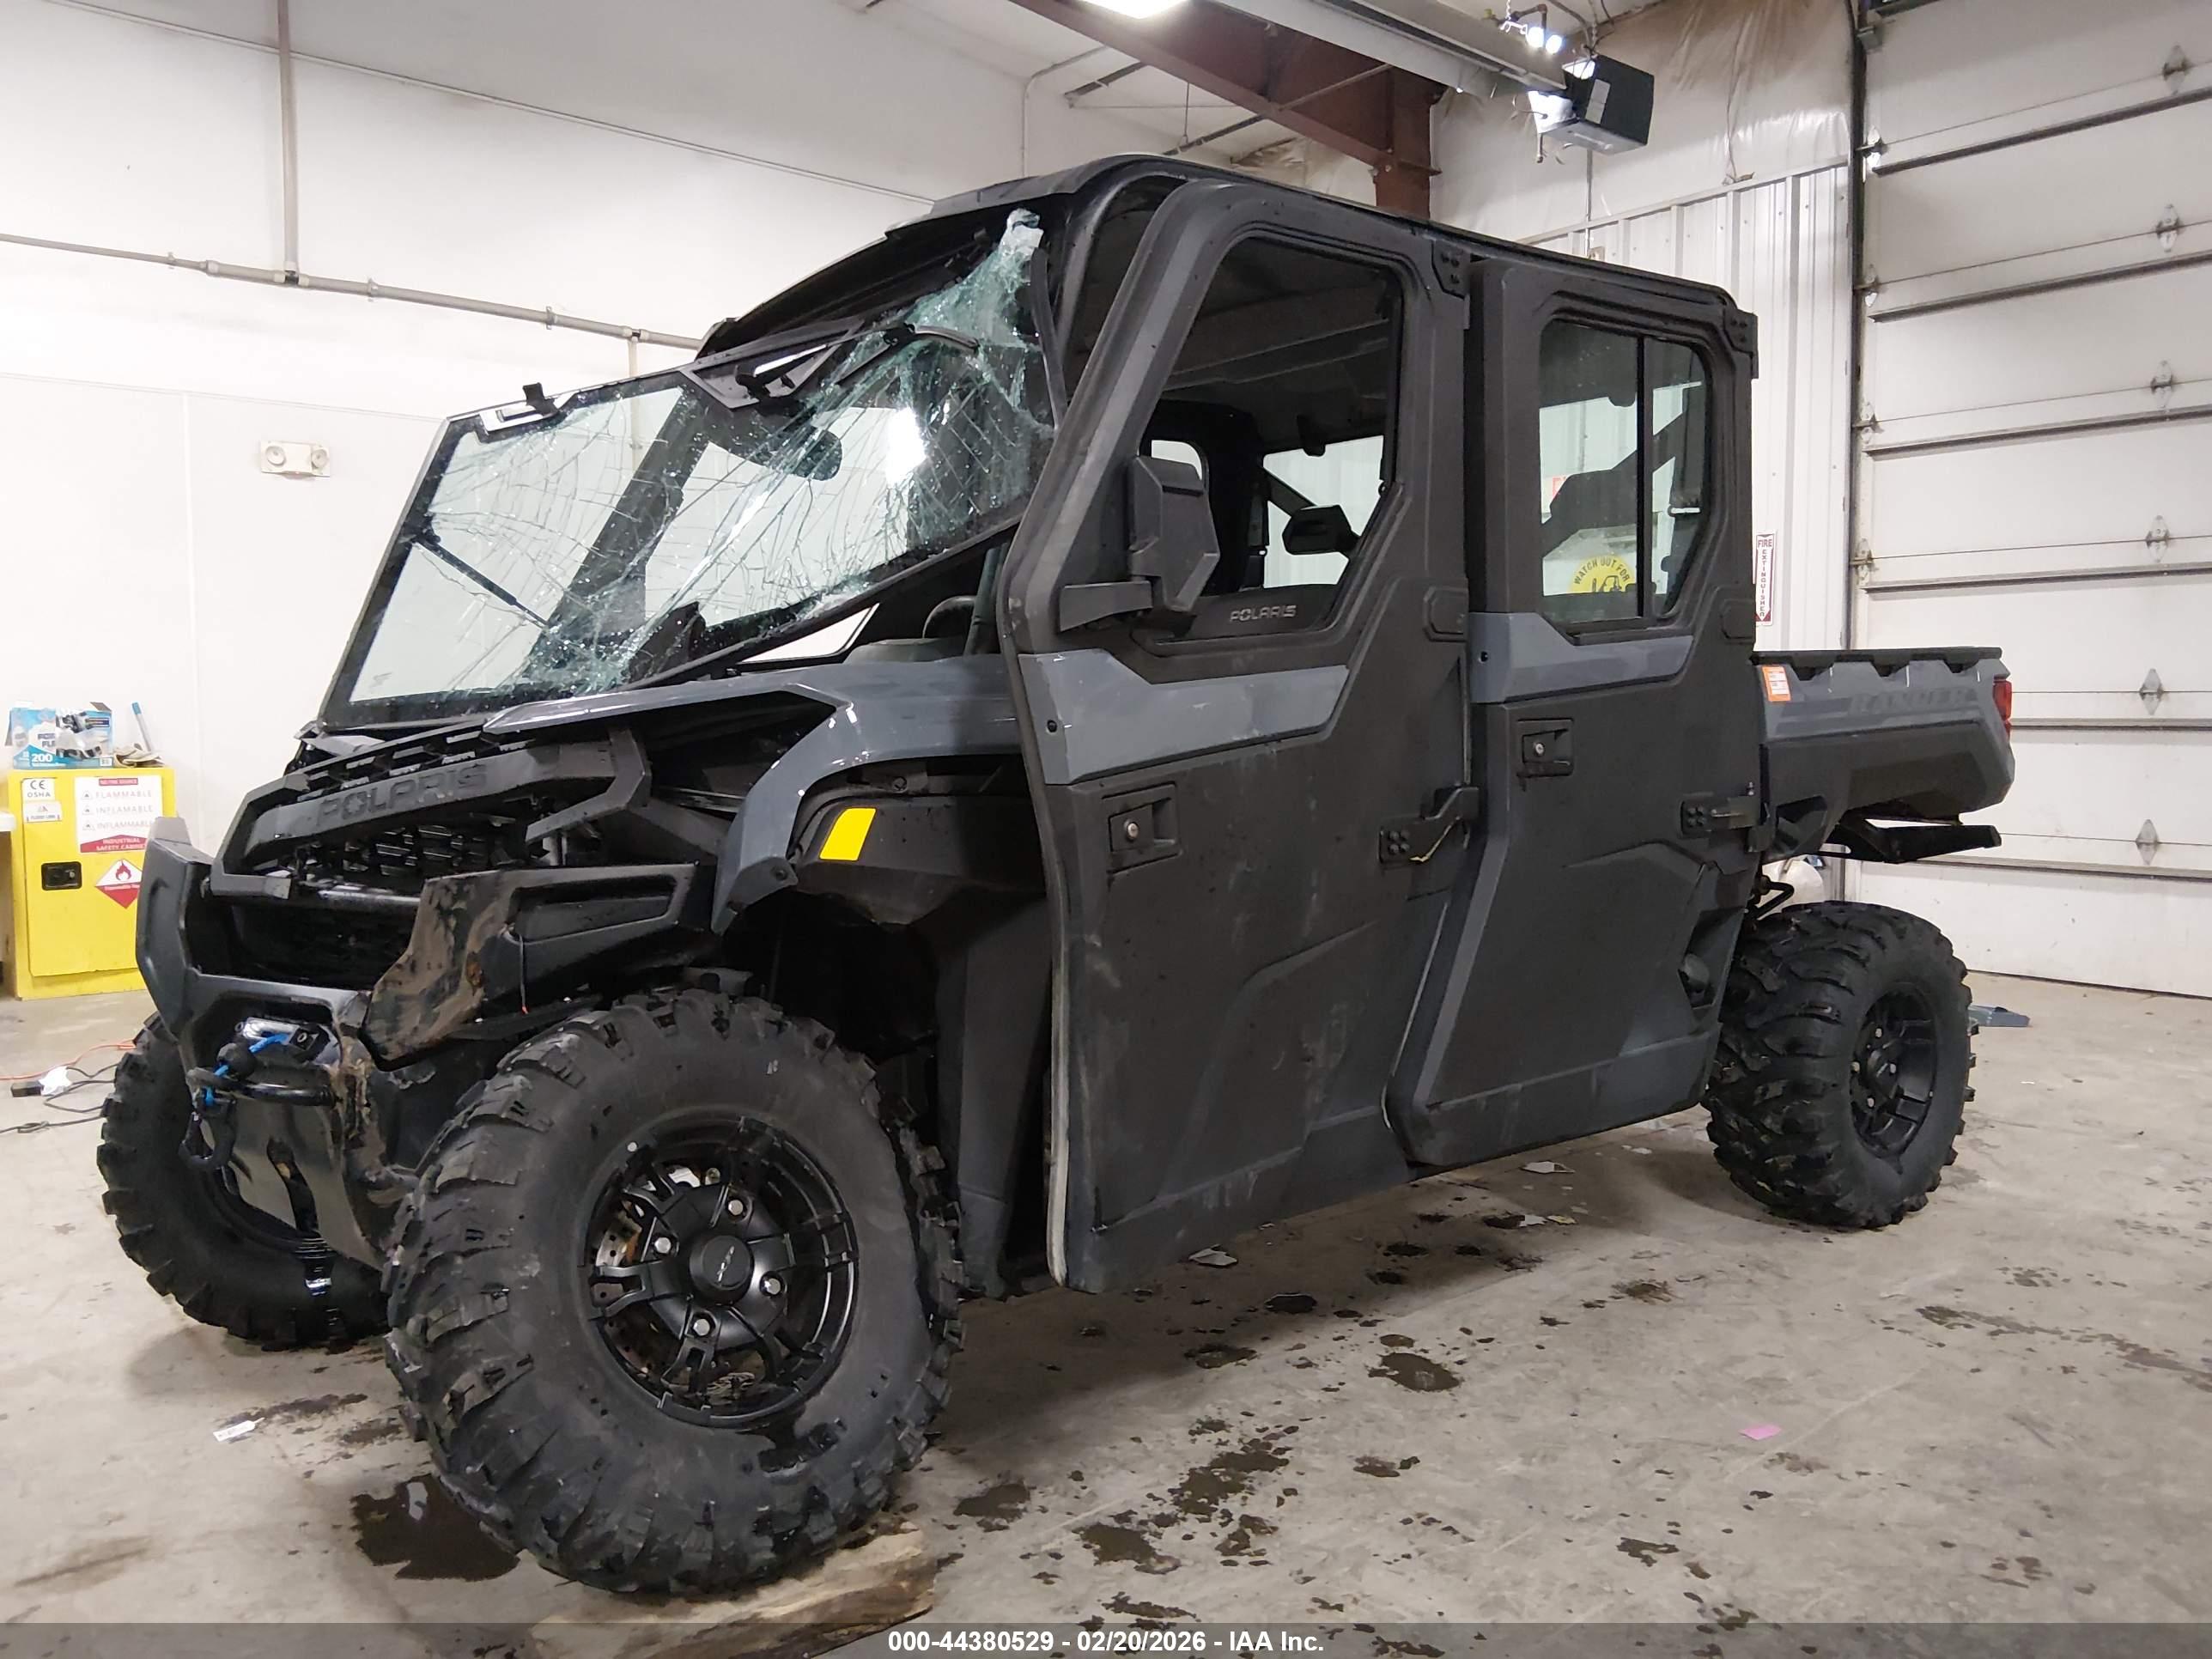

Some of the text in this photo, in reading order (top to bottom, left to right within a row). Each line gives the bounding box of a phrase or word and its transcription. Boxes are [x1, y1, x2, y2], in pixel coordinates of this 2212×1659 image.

[1758, 538, 1772, 548] FIRE
[1574, 556, 1631, 584] WATCH OUT FOR
[1230, 605, 1297, 623] POLARIS
[31, 753, 53, 763] 200
[30, 780, 46, 790] CE
[95, 790, 152, 799] FLAMMABLE
[316, 763, 488, 827] POLARIS
[96, 805, 154, 813] INFLAMABLE
